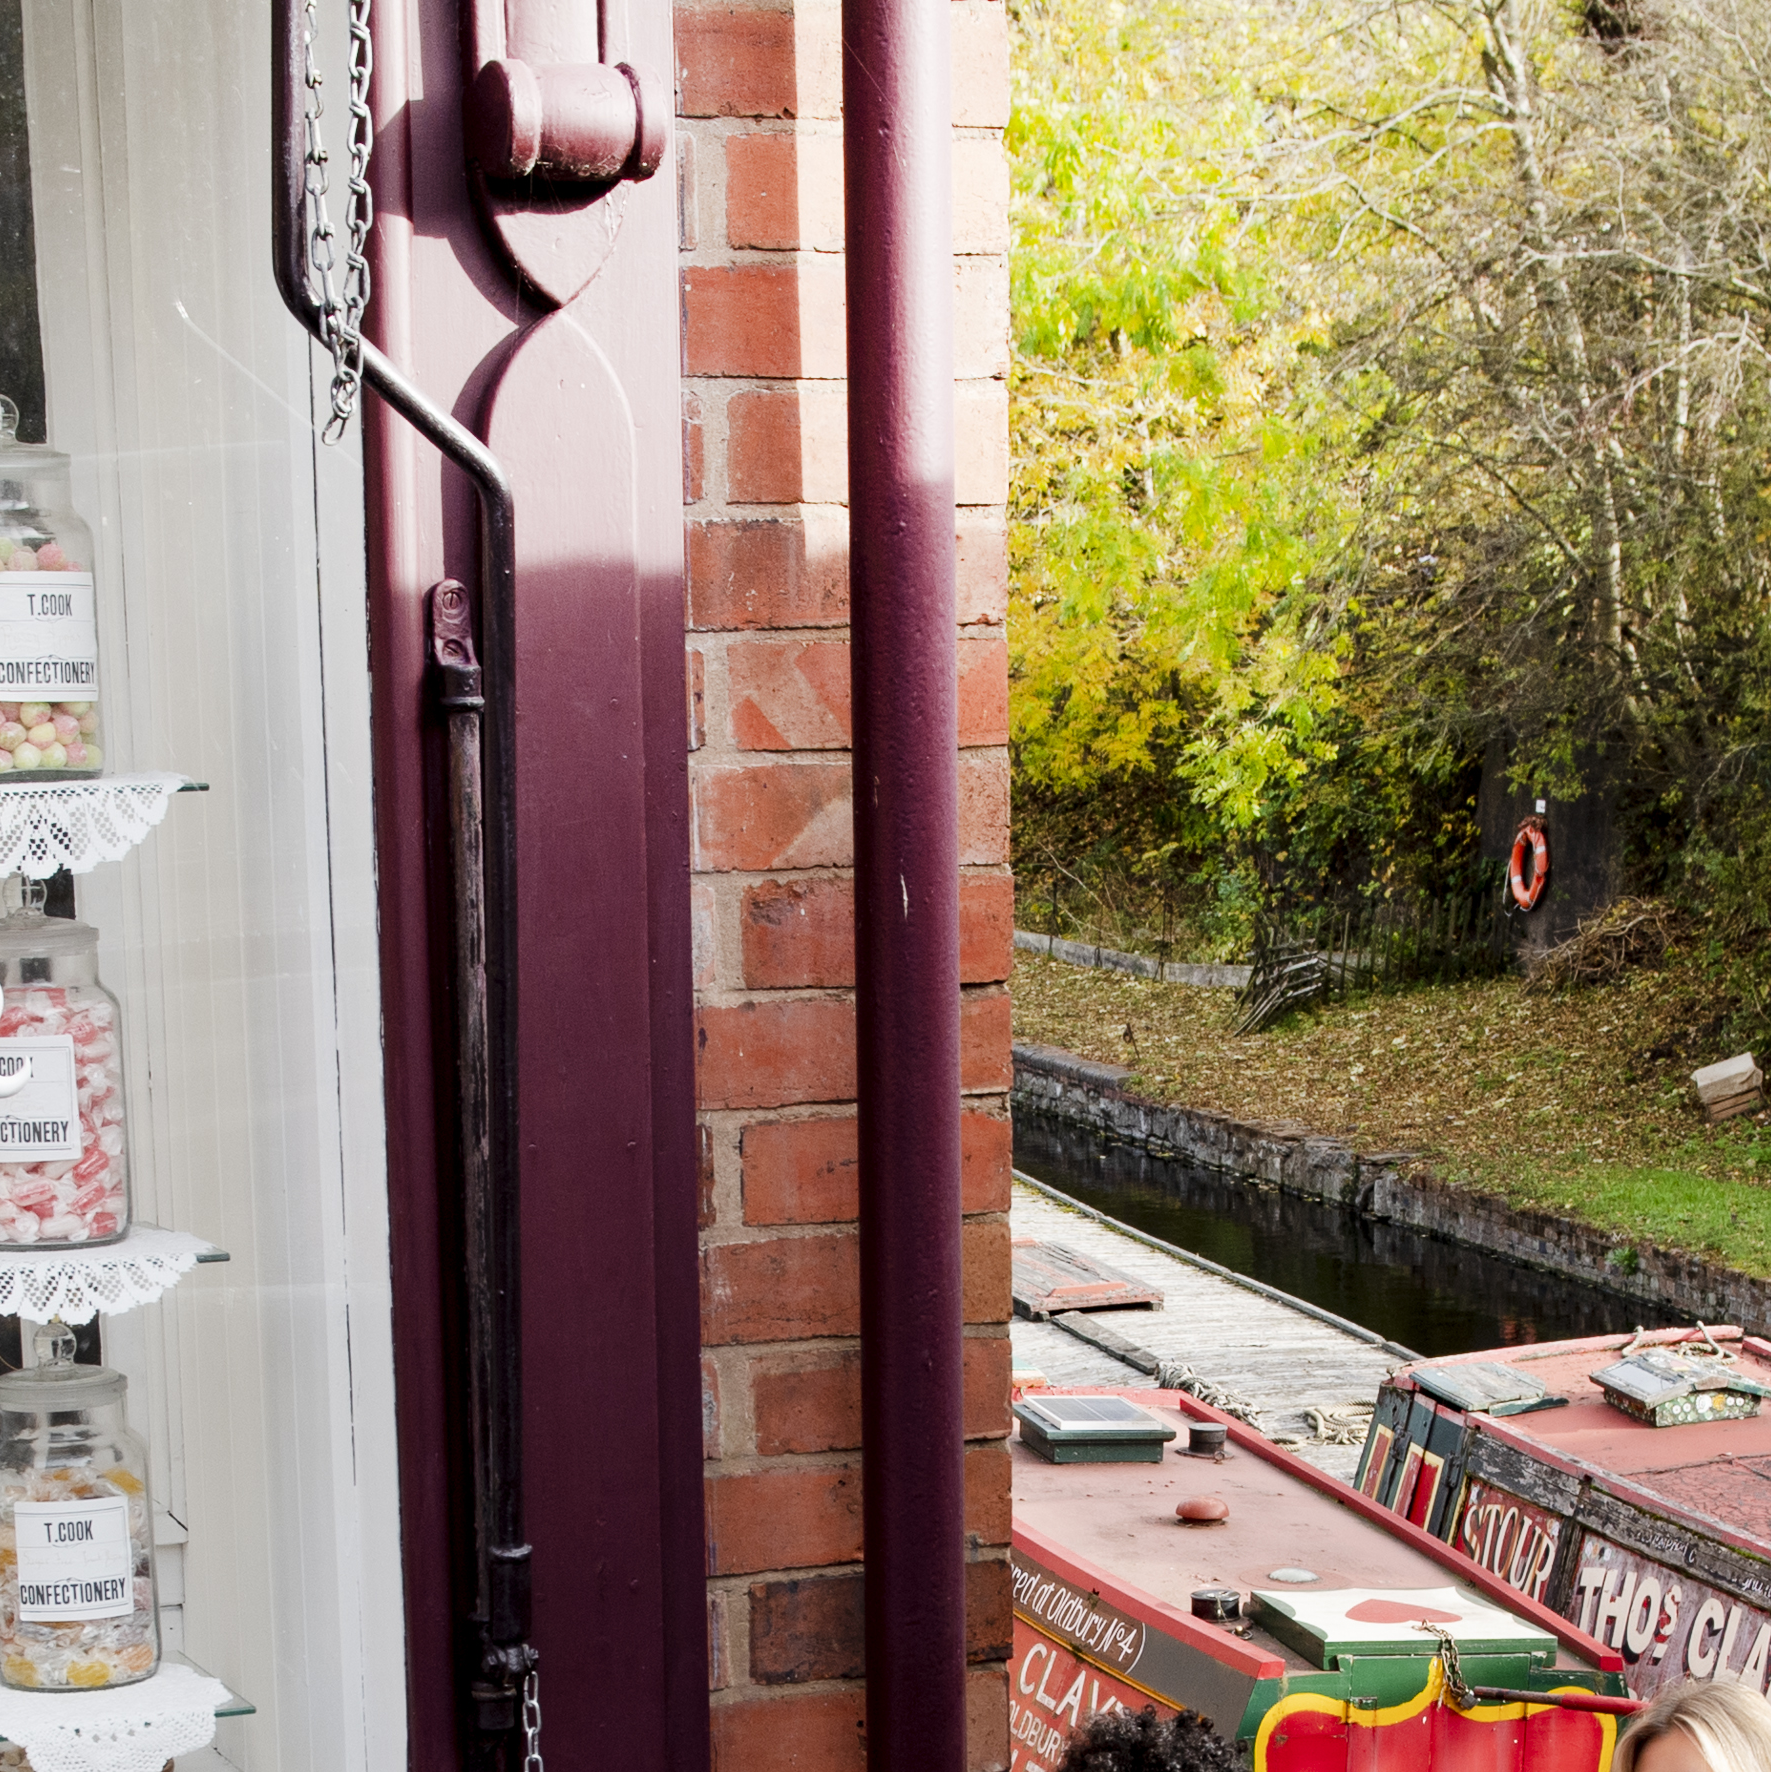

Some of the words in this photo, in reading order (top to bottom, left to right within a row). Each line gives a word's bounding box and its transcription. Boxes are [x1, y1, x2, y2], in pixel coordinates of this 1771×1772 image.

[27, 594, 72, 616] T.COOK
[43, 1520, 93, 1543] T.COOK
[1464, 1504, 1557, 1606] STOUR
[20, 1577, 125, 1605] CONFECTIONERY
[1032, 1582, 1055, 1615] at
[1047, 1587, 1107, 1652] Oldbury
